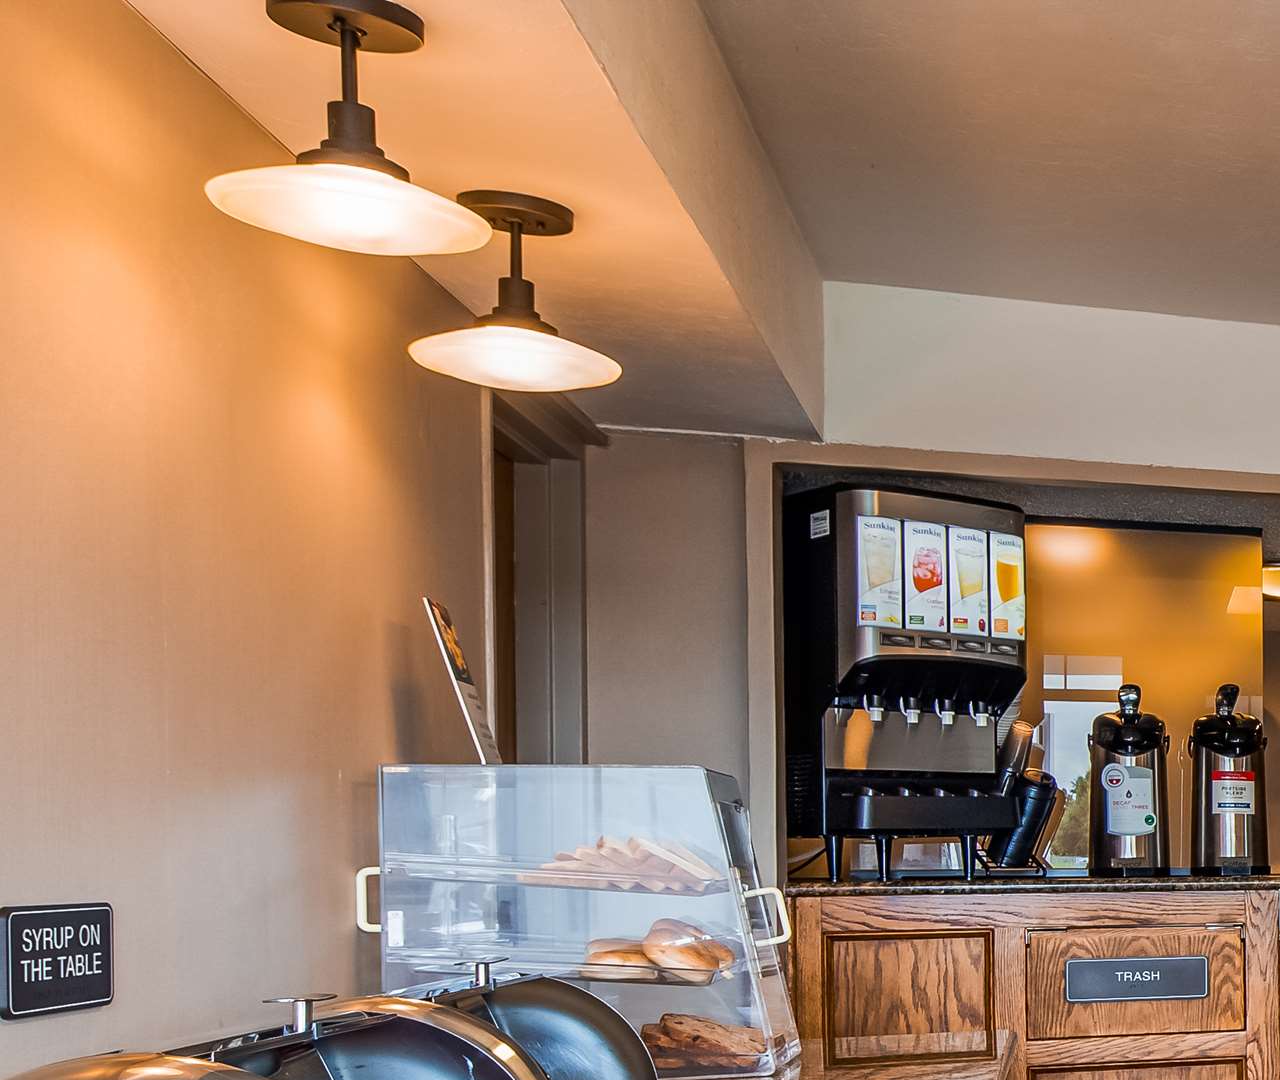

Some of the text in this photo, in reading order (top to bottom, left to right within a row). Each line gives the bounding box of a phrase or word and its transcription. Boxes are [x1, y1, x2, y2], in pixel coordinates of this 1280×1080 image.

[997, 539, 1023, 550] Sunk
[22, 923, 101, 952] SYRUP ON
[20, 952, 103, 983] THE TABLE
[1115, 971, 1161, 982] TRASH
